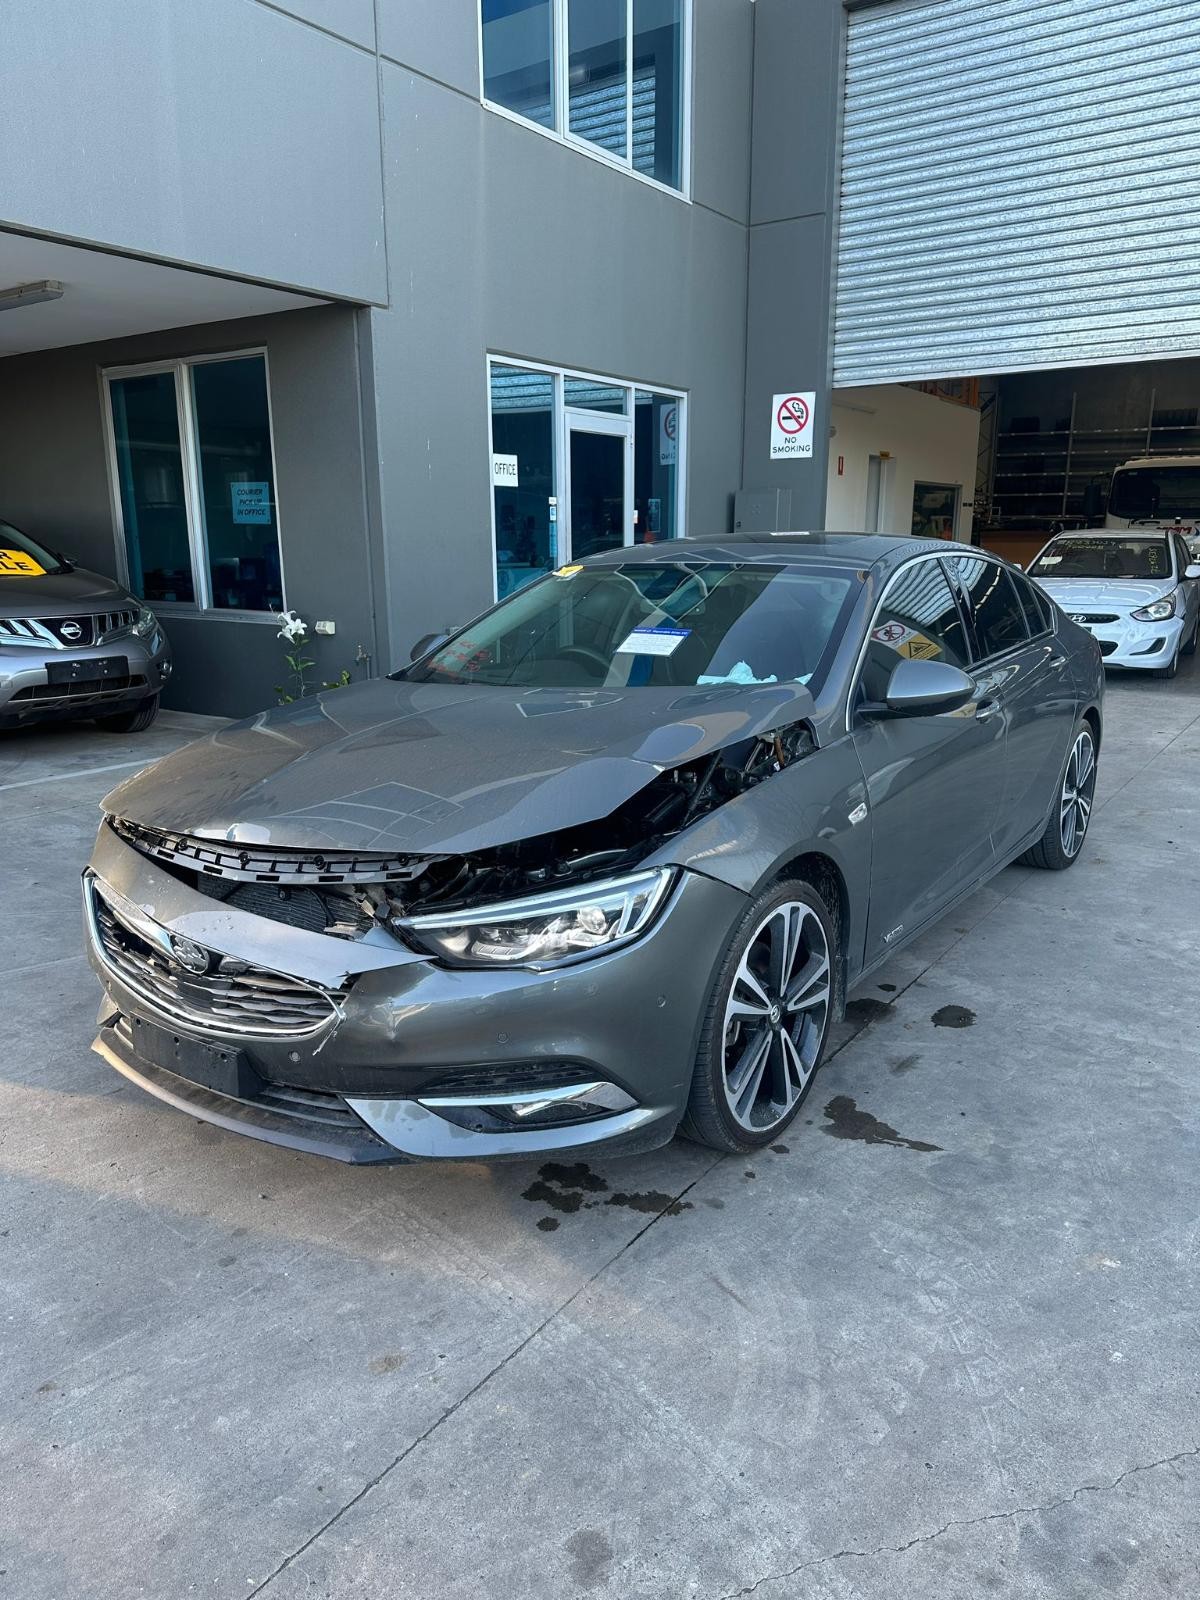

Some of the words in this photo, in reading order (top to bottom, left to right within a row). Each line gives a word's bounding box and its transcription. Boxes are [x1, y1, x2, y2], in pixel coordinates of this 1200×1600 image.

[772, 445, 811, 453] SMOKING
[495, 462, 516, 476] OFFICE
[0, 561, 33, 570] LE
